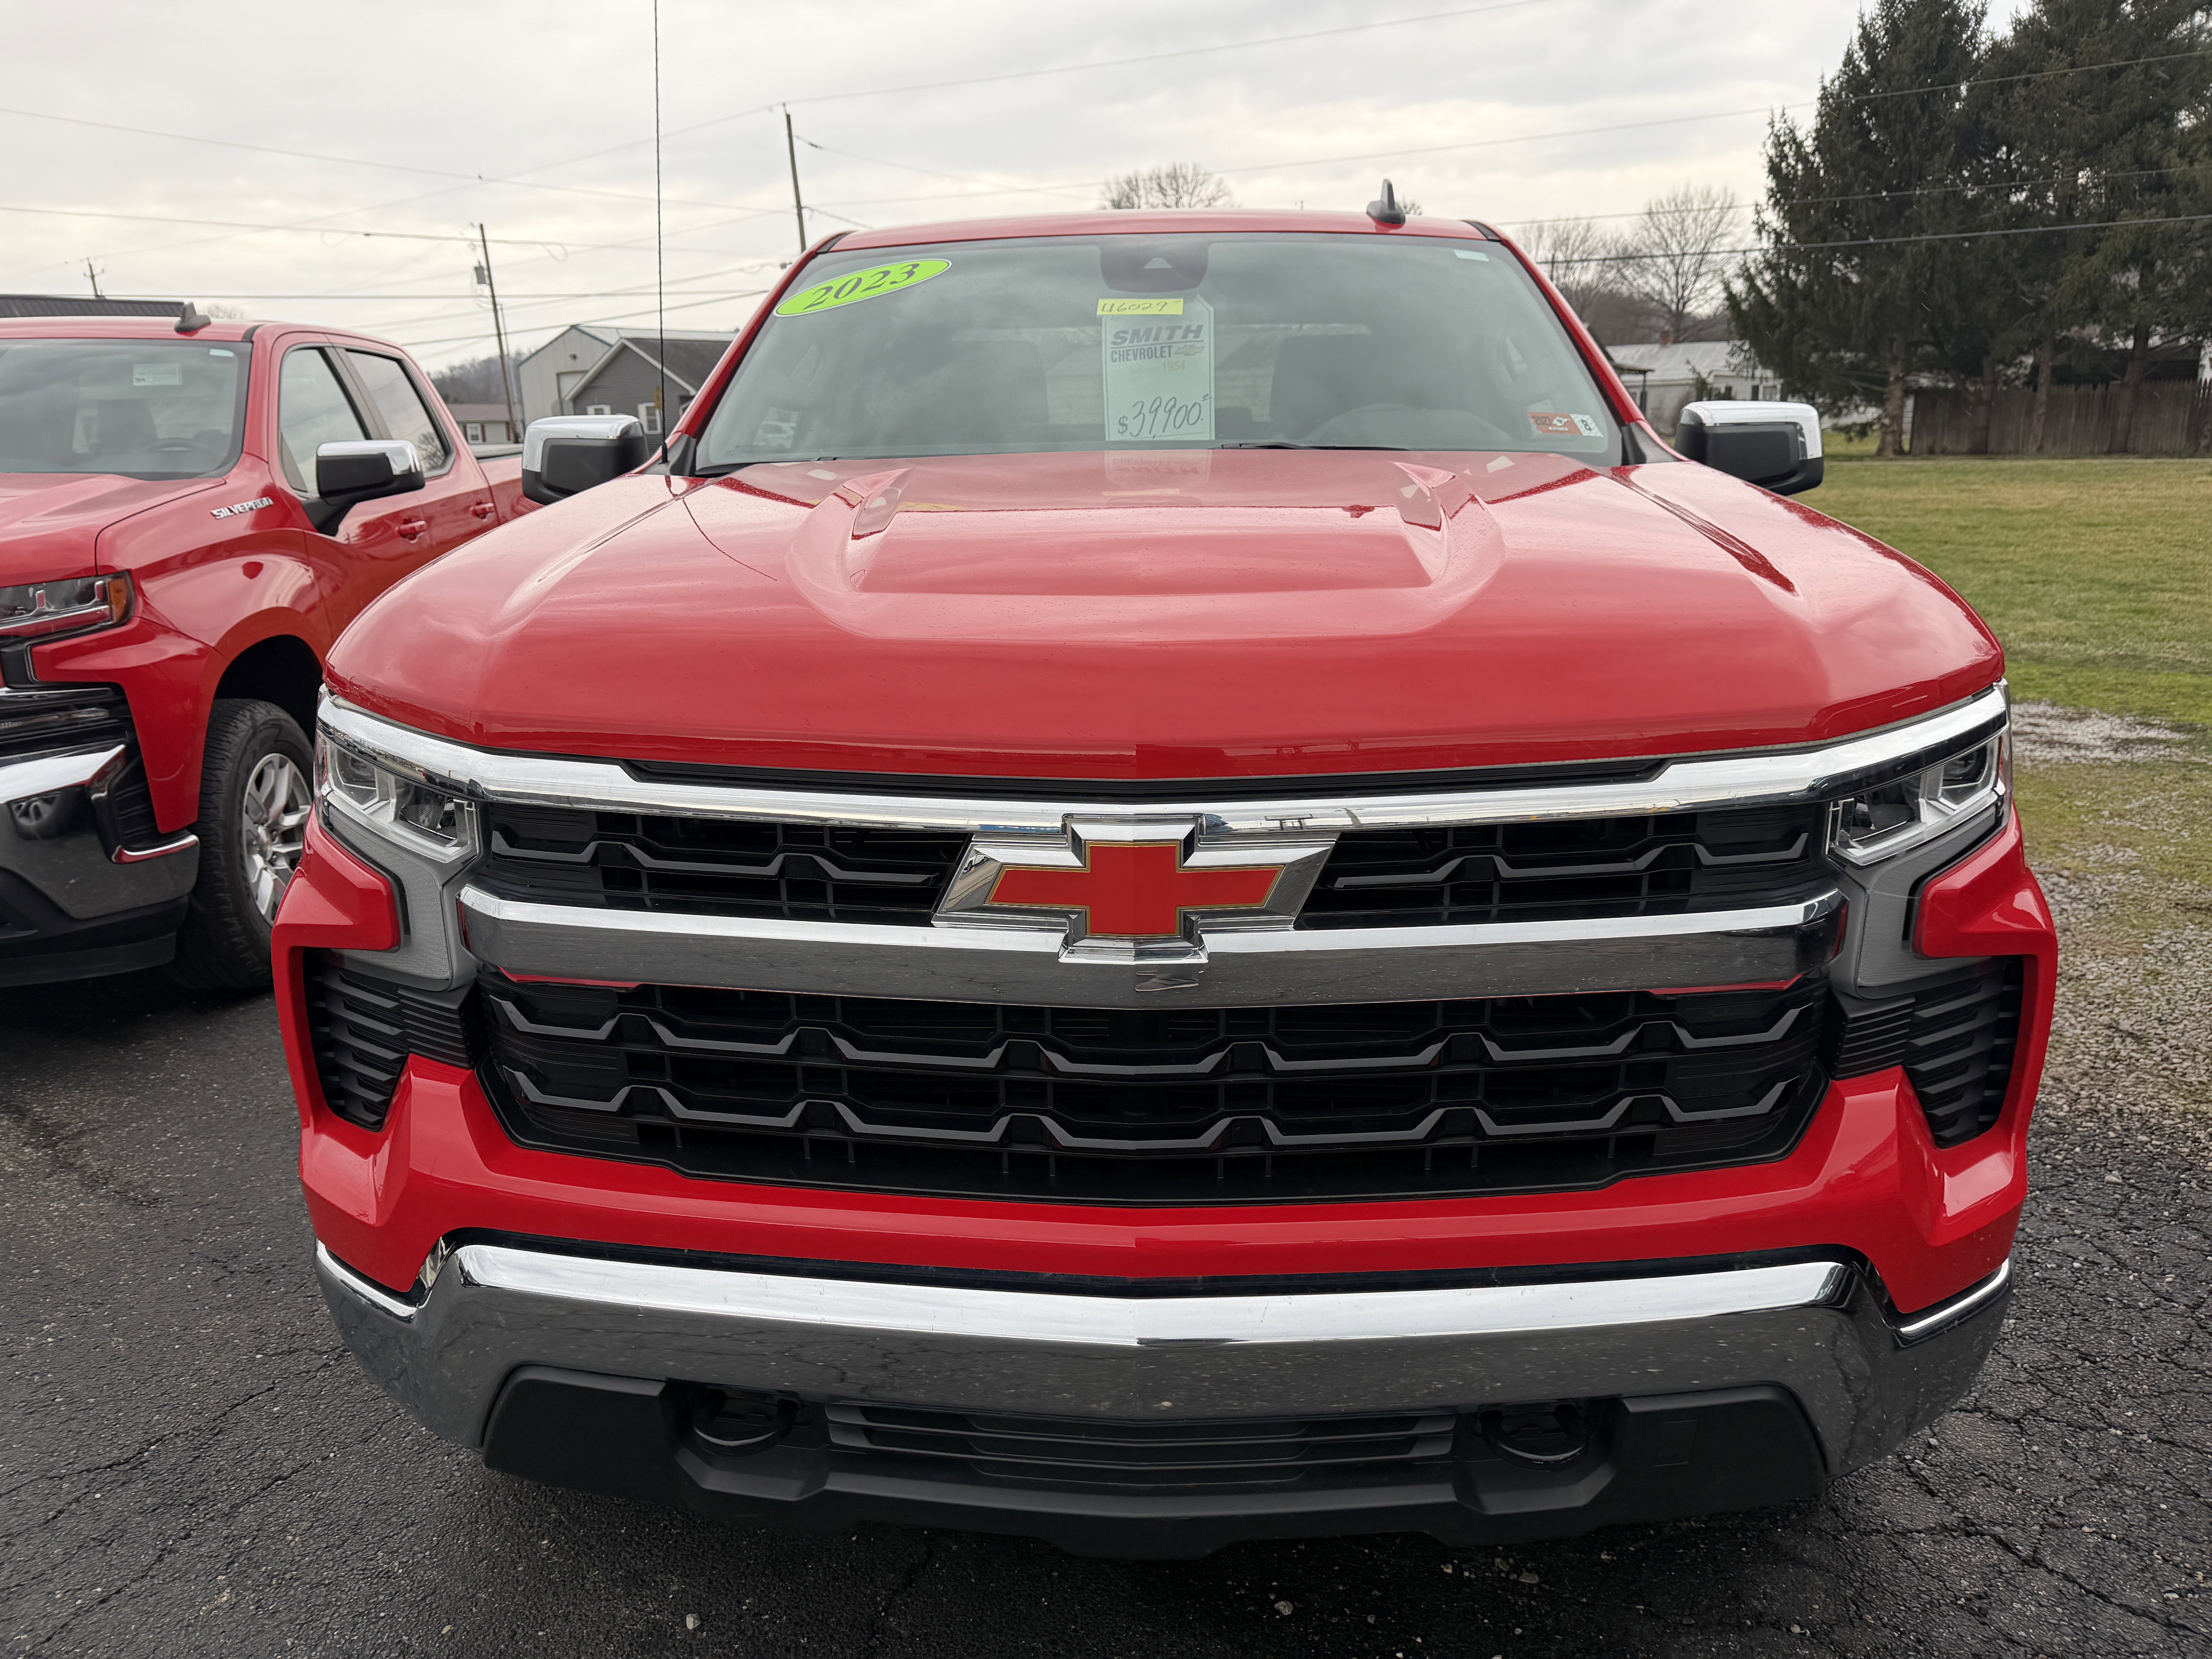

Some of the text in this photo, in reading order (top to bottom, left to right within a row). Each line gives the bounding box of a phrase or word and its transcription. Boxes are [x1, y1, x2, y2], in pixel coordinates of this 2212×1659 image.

[802, 263, 920, 310] 2023
[1111, 325, 1204, 345] SMITH
[1111, 345, 1173, 362] CHEVROLET
[1162, 360, 1186, 372] 1954
[1581, 419, 1592, 431] 8
